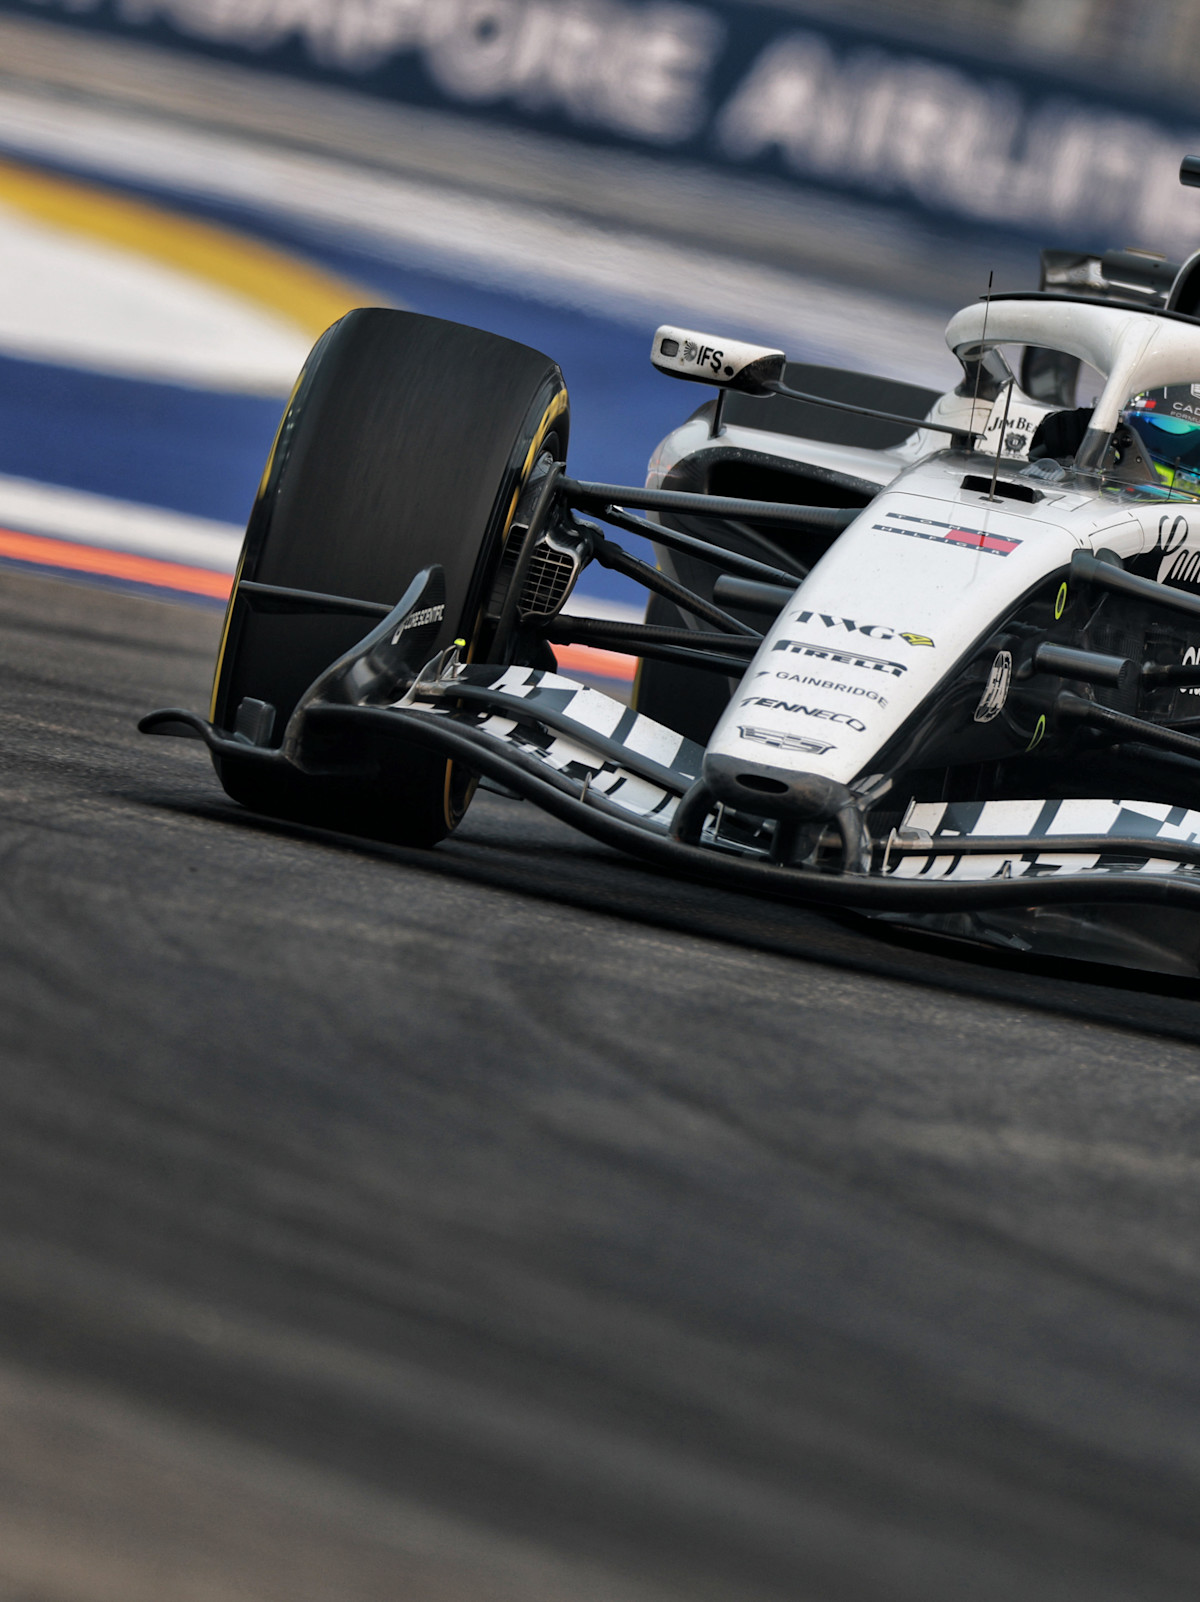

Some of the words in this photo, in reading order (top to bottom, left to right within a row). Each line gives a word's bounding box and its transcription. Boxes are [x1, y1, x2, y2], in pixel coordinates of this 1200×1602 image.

[696, 345, 724, 371] IFS
[988, 417, 1015, 431] JIM
[1016, 417, 1038, 434] BE
[881, 526, 1000, 554] HILFIGER
[896, 514, 1016, 541] TOMMY
[790, 609, 895, 640] TWG
[771, 639, 908, 678] PIRELLI
[776, 671, 888, 709] GAINBRIDGE
[741, 696, 867, 732] TENNECO
